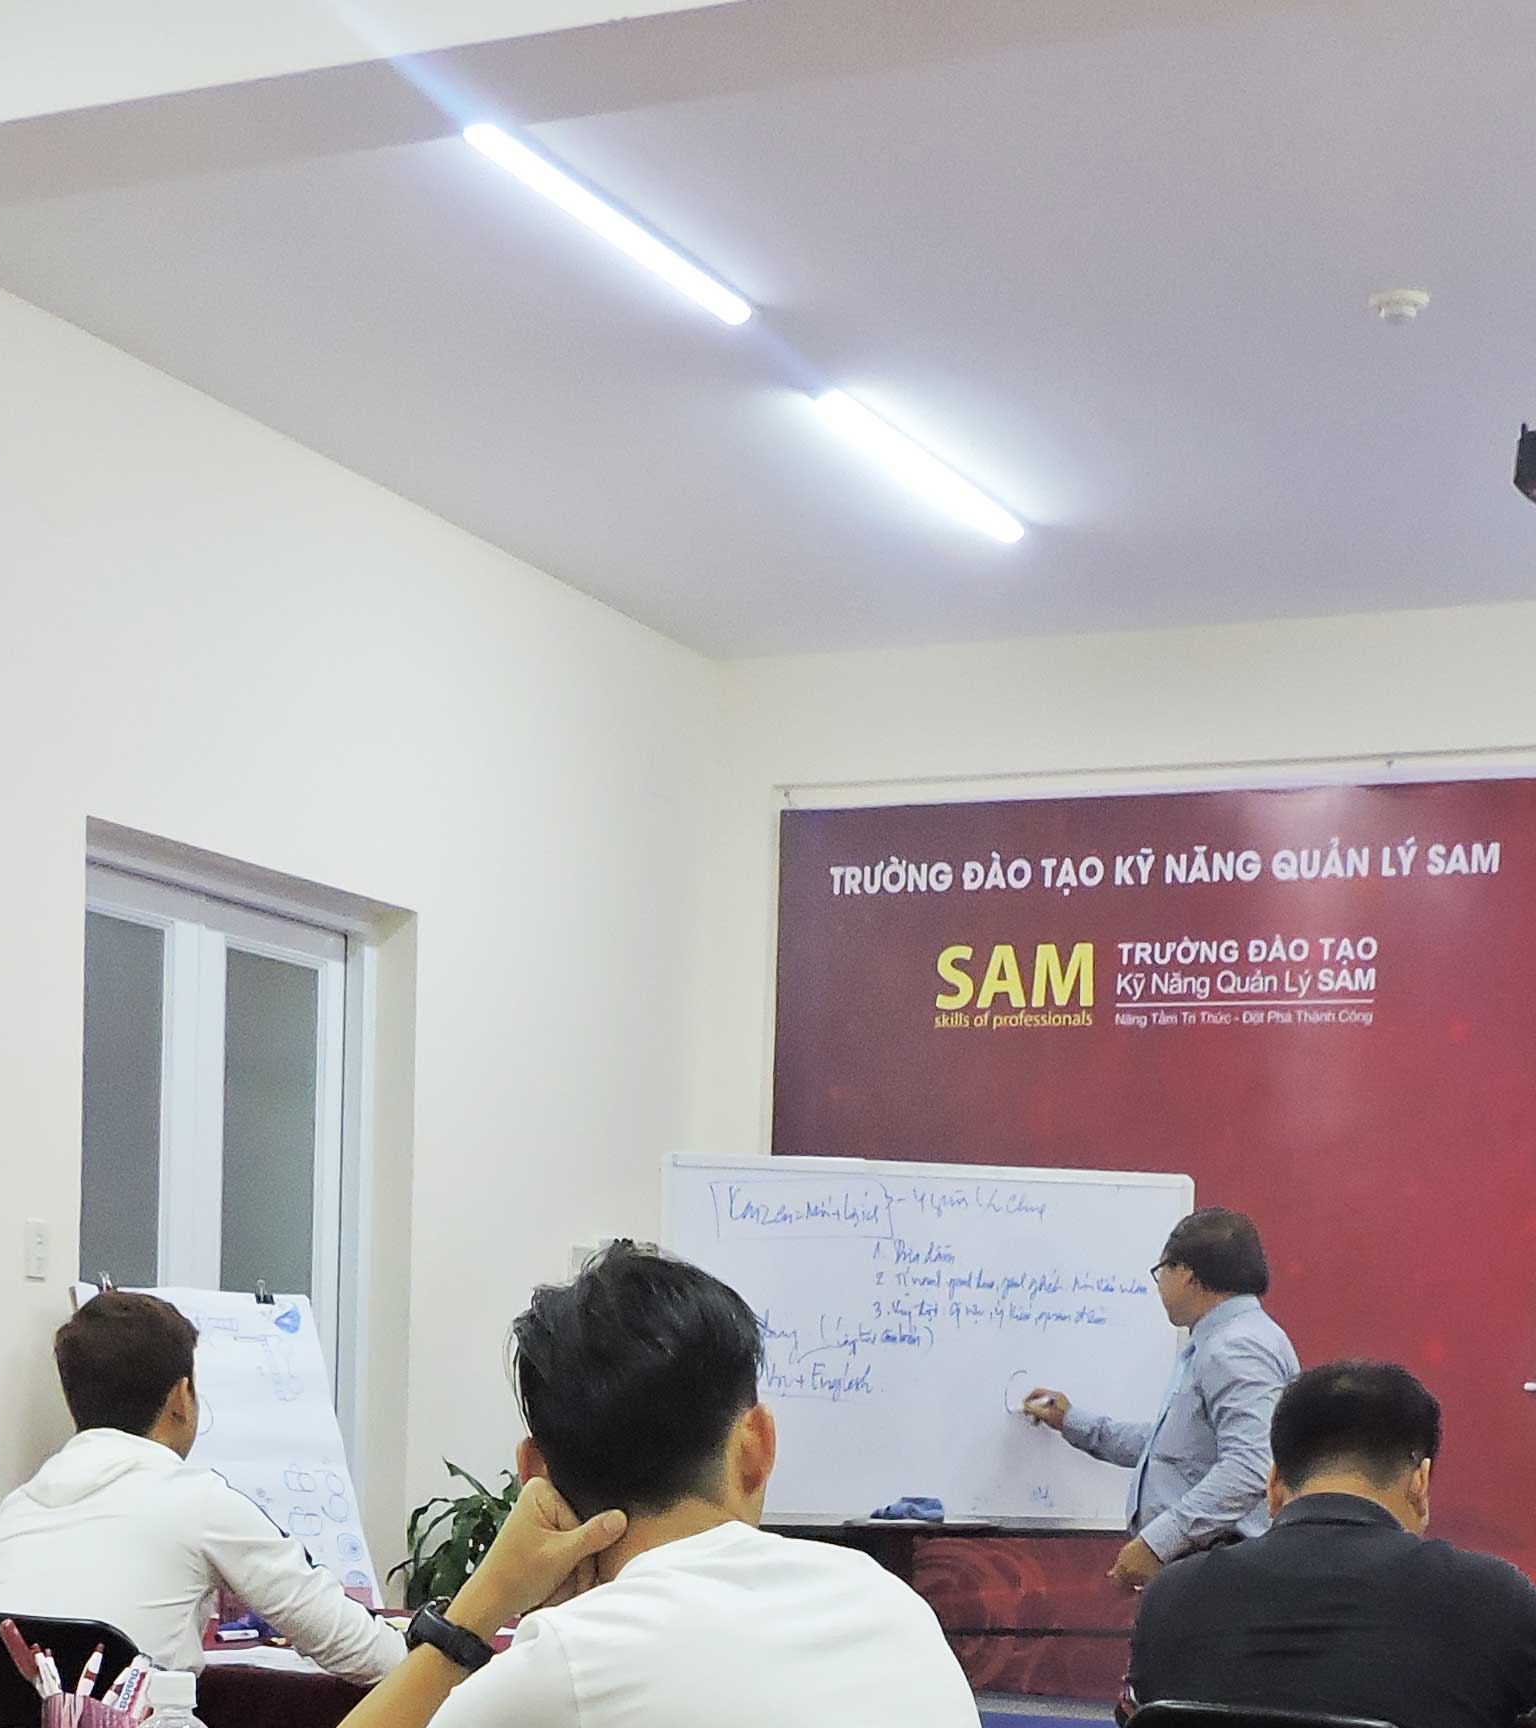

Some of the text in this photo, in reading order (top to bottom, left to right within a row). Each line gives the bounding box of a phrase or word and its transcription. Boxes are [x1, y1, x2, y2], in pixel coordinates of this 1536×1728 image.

[829, 836, 1501, 897] TRƯỜNG ĐÀO TẠO KỸ NĂNG QUẢN LÝ SAM
[1117, 934, 1378, 966] TRƯỜNG ĐÀO TẠO
[935, 943, 1094, 1010] SAM
[1116, 967, 1376, 1000] Kỹ Năng Quản Lý SAM
[934, 1009, 1093, 1029] skills of professionals
